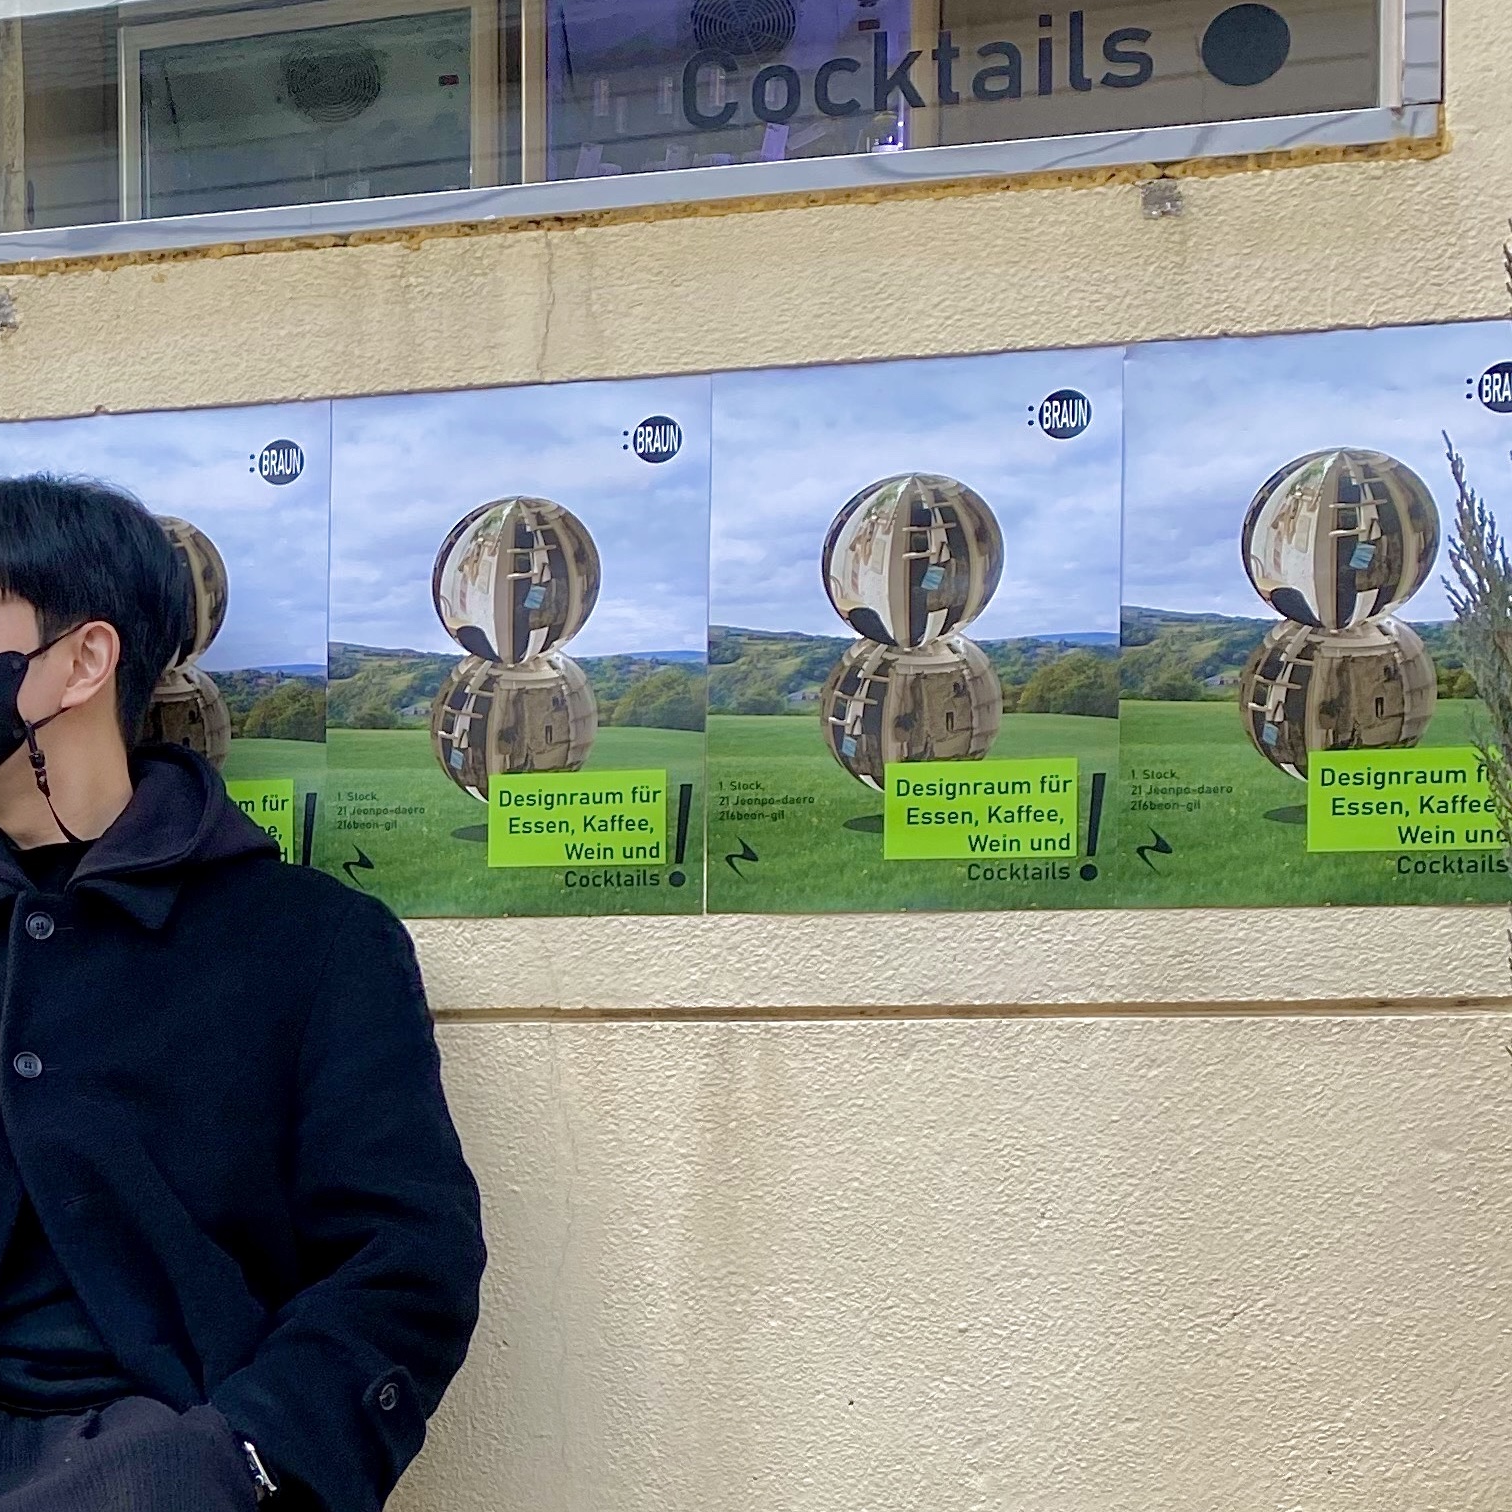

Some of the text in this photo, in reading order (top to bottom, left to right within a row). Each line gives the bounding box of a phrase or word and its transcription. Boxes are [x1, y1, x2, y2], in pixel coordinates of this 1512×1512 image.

[683, 10, 1154, 129] Cocktails
[896, 774, 1073, 800] Designraum für
[1321, 766, 1467, 790] Designraum
[499, 785, 662, 810] Designraum für
[1131, 784, 1142, 795] 21
[261, 794, 290, 812] für
[719, 796, 729, 806] 21
[1331, 797, 1410, 818] Essen,
[509, 814, 654, 836] Essen, Kaffee,
[907, 805, 1064, 828] Essen, Kaffee,
[968, 832, 1071, 853] Wein und
[1397, 825, 1455, 844] Wein
[564, 841, 660, 860] Wein und
[967, 862, 1071, 881] Cocktails
[1397, 854, 1509, 875] Cocktails
[564, 869, 660, 888] Cocktails
